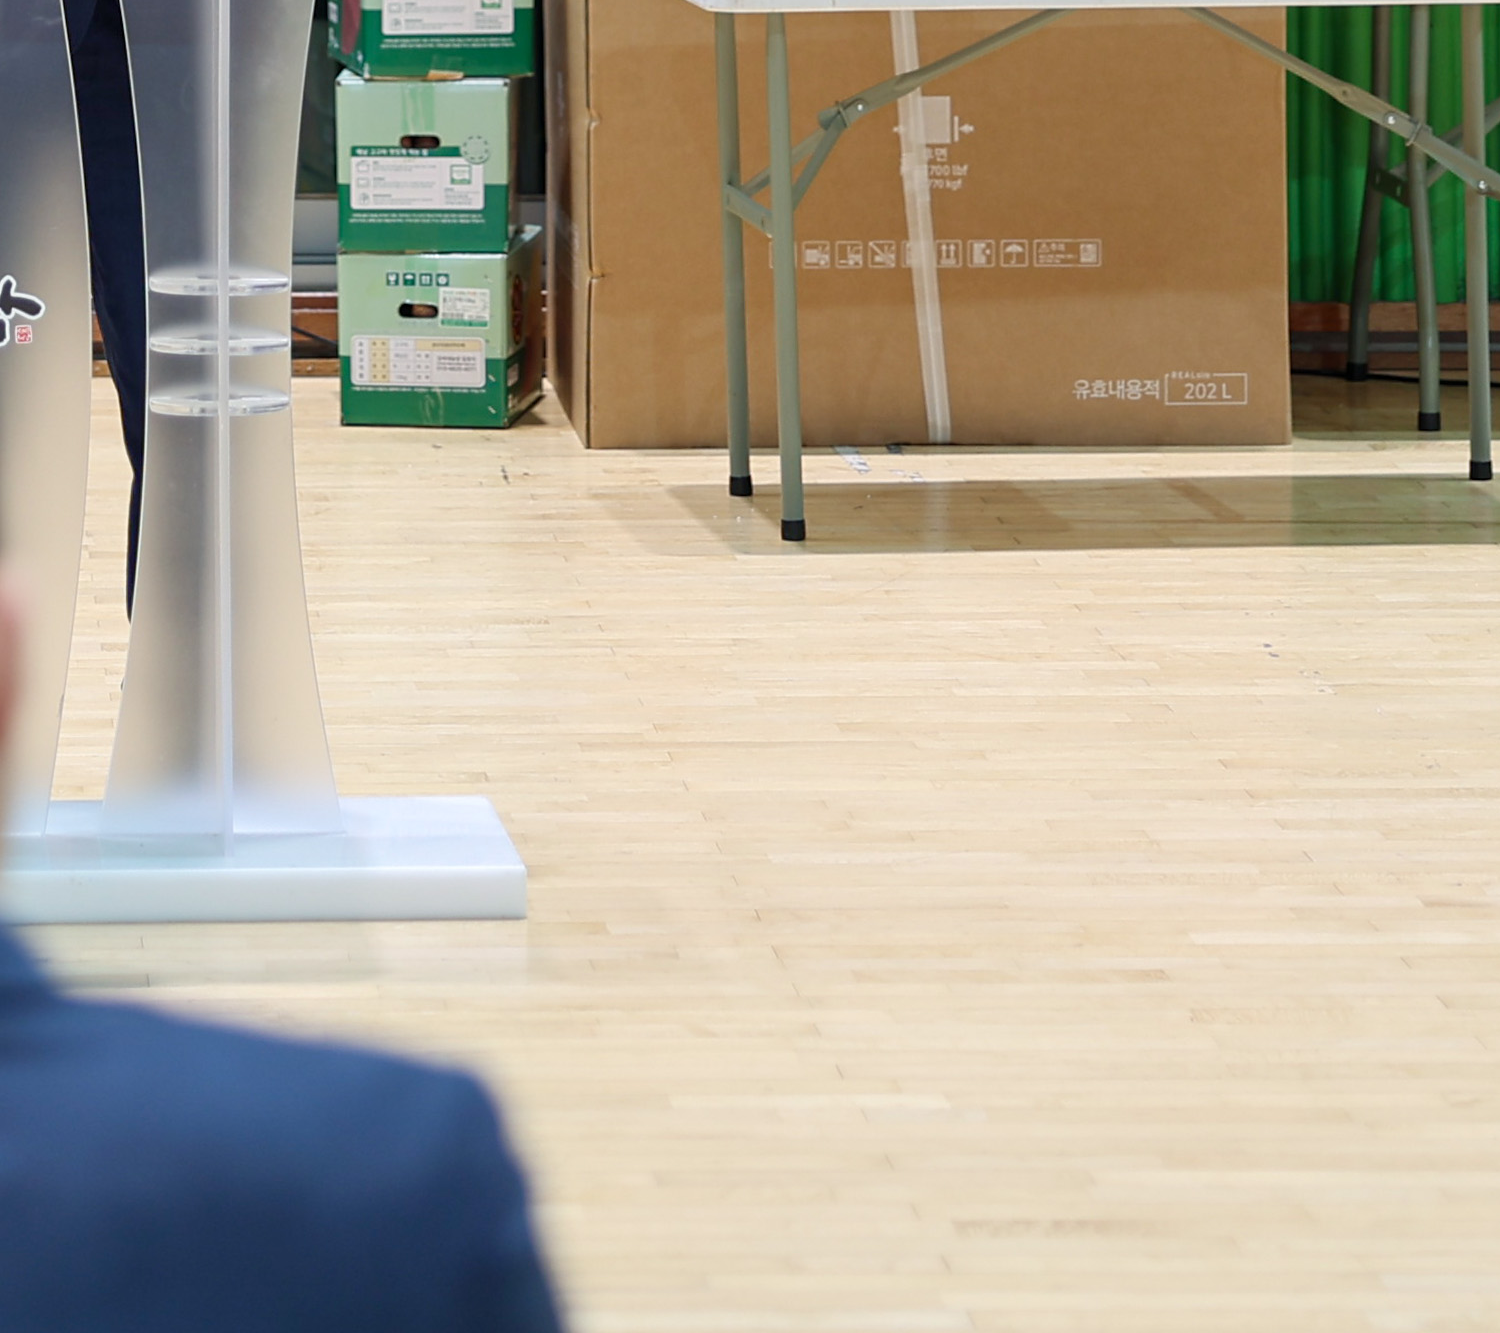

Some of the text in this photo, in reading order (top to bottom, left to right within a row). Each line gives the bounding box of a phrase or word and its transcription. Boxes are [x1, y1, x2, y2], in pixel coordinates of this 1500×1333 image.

[1071, 378, 1161, 401] 유효내용적
[1183, 382, 1233, 400] 202 L
